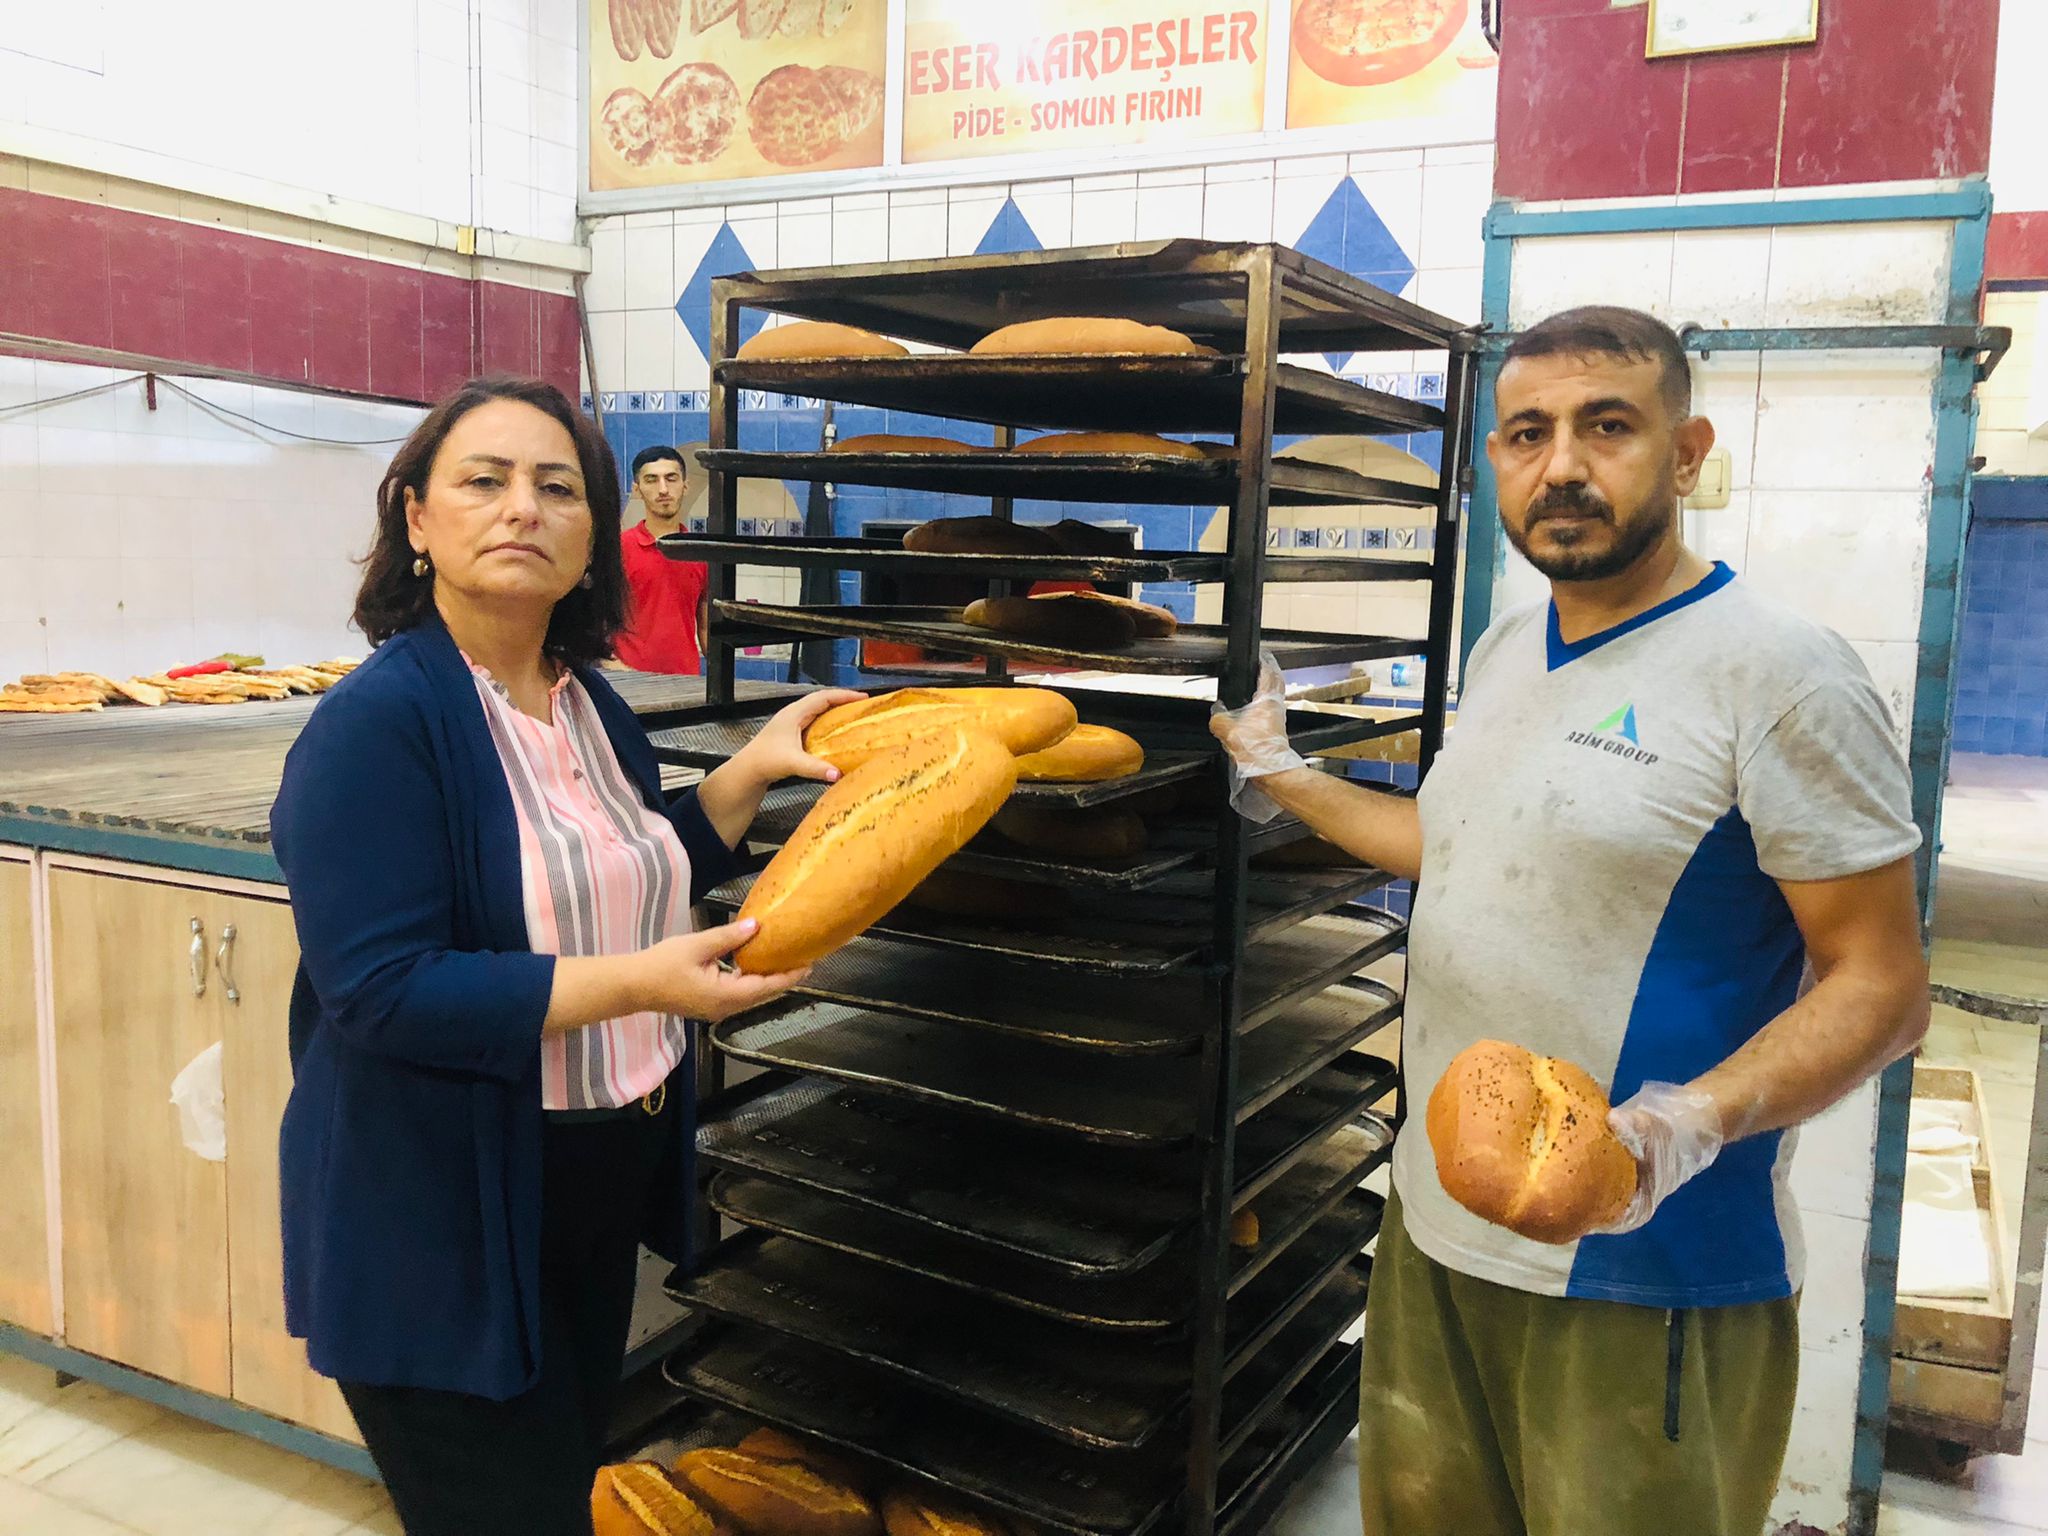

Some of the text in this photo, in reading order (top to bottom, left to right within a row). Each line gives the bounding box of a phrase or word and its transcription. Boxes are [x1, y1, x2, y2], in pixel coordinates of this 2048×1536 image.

[910, 10, 1258, 95] ESER KARDEŞLER
[953, 103, 1005, 140] PİDE
[1030, 94, 1115, 132] SOMUN
[1125, 86, 1202, 126] FIRINI
[1564, 731, 1659, 766] AZİM GROUP
